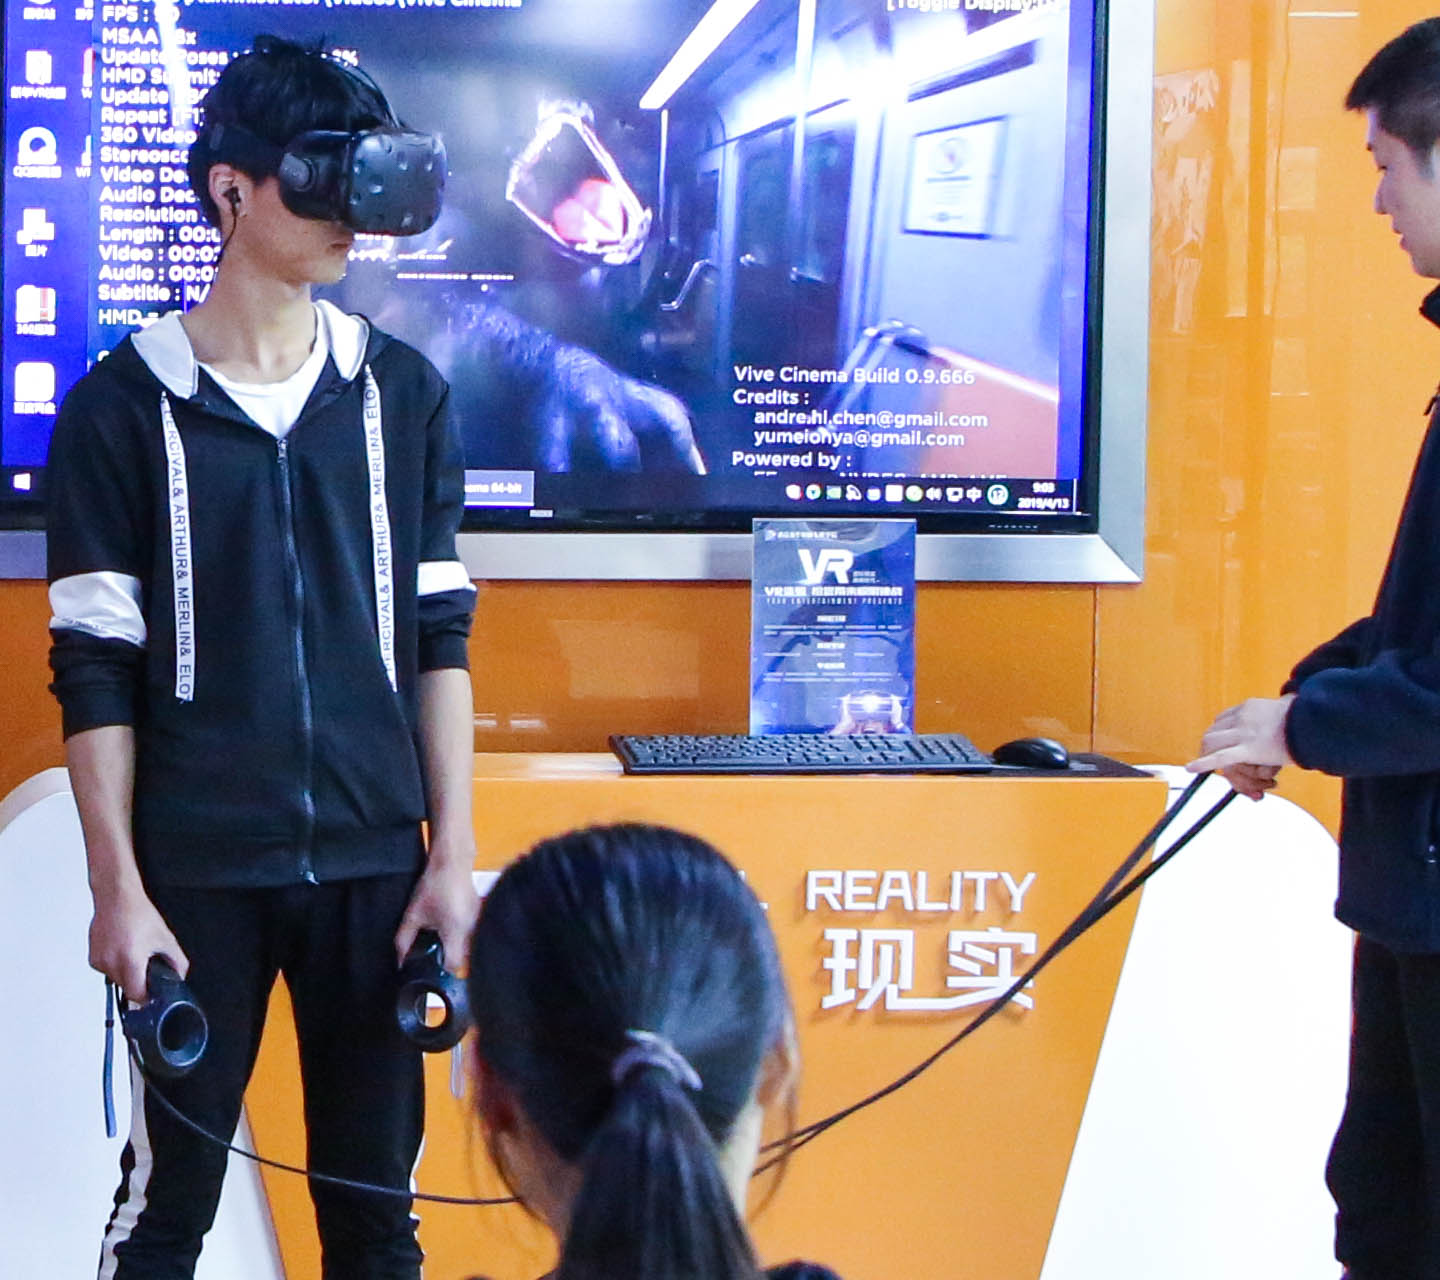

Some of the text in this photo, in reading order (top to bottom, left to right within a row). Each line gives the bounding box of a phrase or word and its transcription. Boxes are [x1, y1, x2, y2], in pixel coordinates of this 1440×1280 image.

[102, 5, 138, 22] FPS
[154, 5, 180, 22] 0
[102, 27, 158, 45] MSAA
[178, 49, 228, 66] oses
[101, 67, 146, 84] HMD
[101, 87, 169, 107] Update
[101, 106, 168, 125] Repeat
[101, 126, 198, 143] 360 Video
[99, 166, 155, 183] Video
[160, 167, 189, 183] De
[99, 186, 201, 203] Audio Dec
[99, 206, 199, 223] Resolution
[99, 225, 164, 244] Length
[98, 245, 154, 261] Video
[98, 265, 155, 281] Audio
[169, 265, 219, 282] 00:0
[98, 284, 171, 301] Subtitle
[186, 284, 211, 303] N/
[98, 309, 142, 325] HMD
[734, 366, 976, 385] Vive Cinema Build 0.9.666
[733, 389, 799, 405] Credits
[732, 452, 812, 468] Powered
[818, 452, 842, 470] by
[798, 549, 854, 584] VR
[177, 586, 192, 657] MERLIN&
[806, 870, 1037, 912] REALITY
[821, 927, 1037, 1010] 现实
